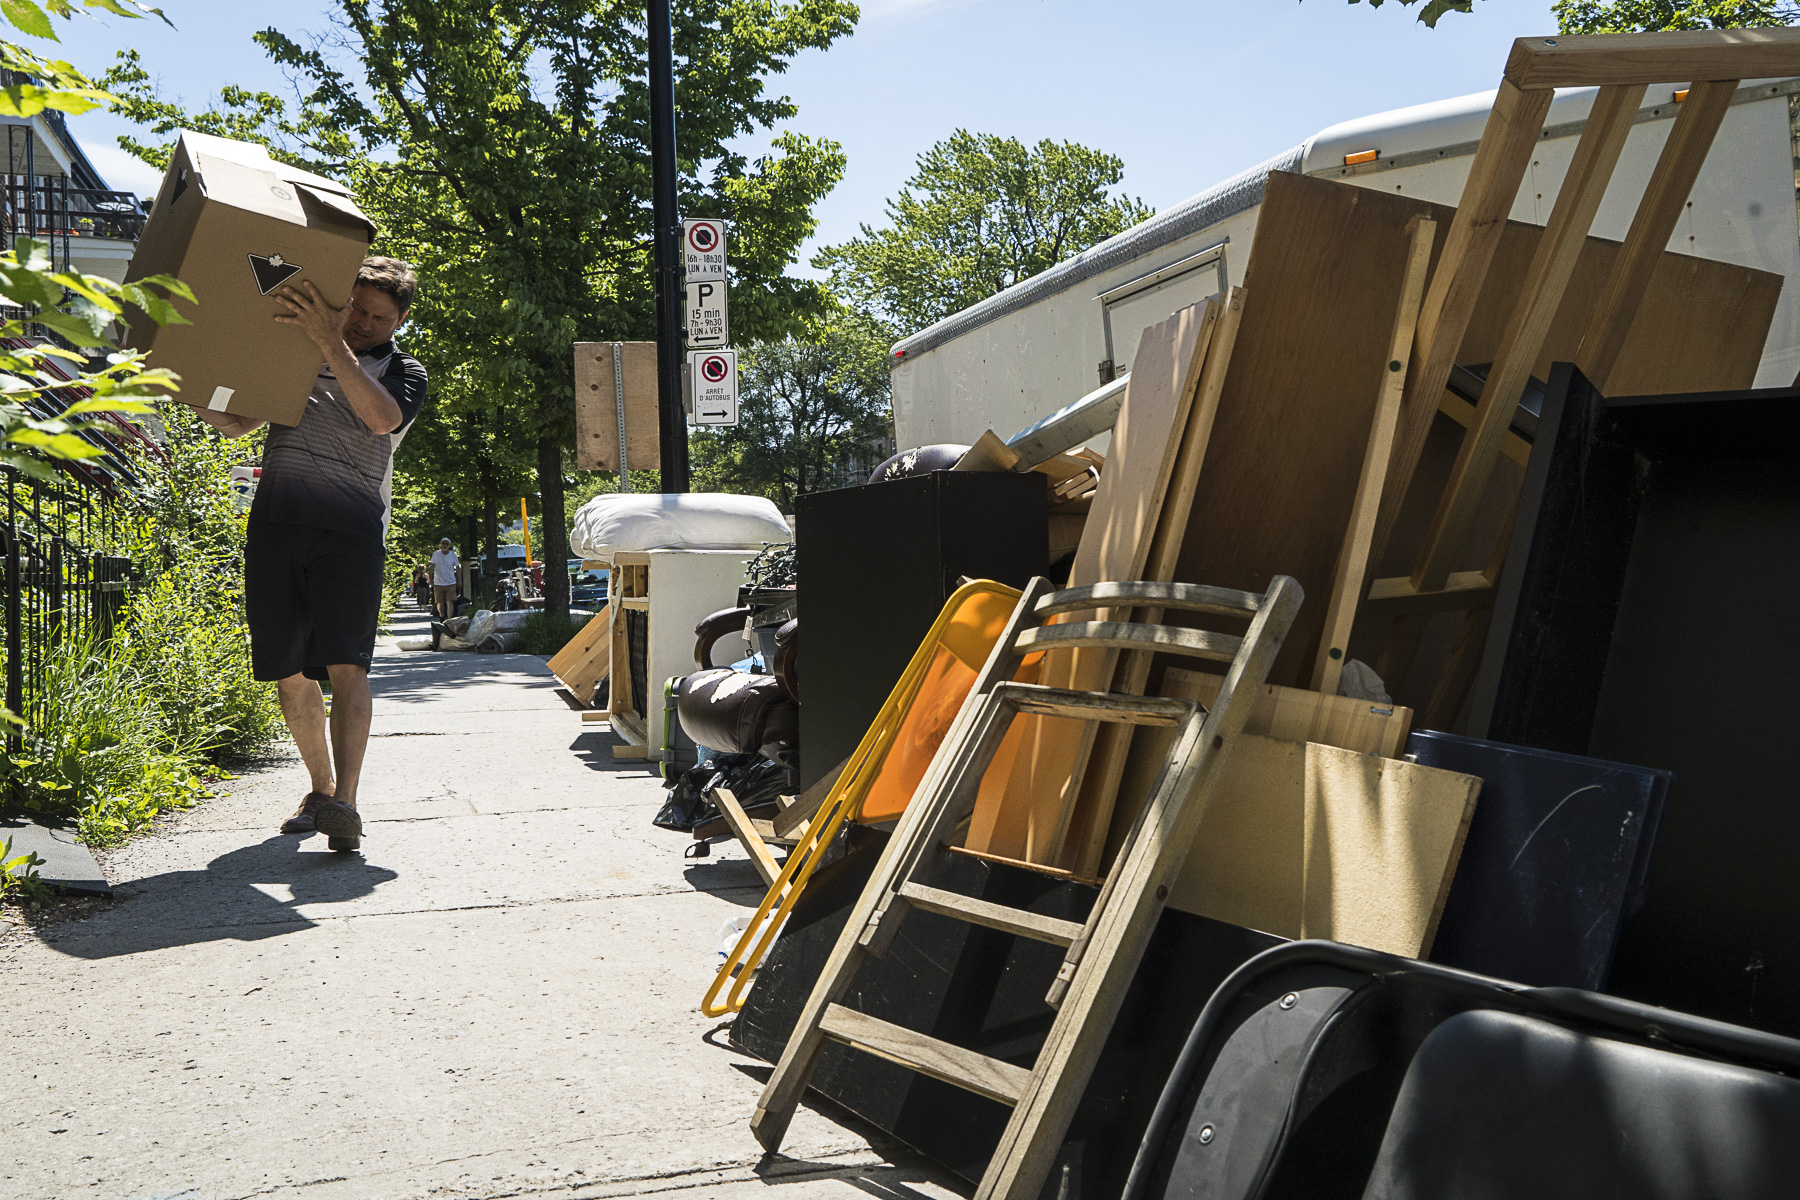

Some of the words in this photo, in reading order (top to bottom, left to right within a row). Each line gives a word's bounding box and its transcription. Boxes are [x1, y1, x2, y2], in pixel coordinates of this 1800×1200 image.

[687, 254, 698, 263] 16h
[704, 255, 722, 263] 18h30
[688, 264, 700, 273] LUN
[710, 265, 722, 273] VEN
[699, 284, 714, 307] P
[692, 309, 701, 319] 15
[704, 308, 720, 318] min
[705, 318, 722, 326] 9h30
[690, 328, 703, 336] LUN
[710, 327, 723, 335] VEN
